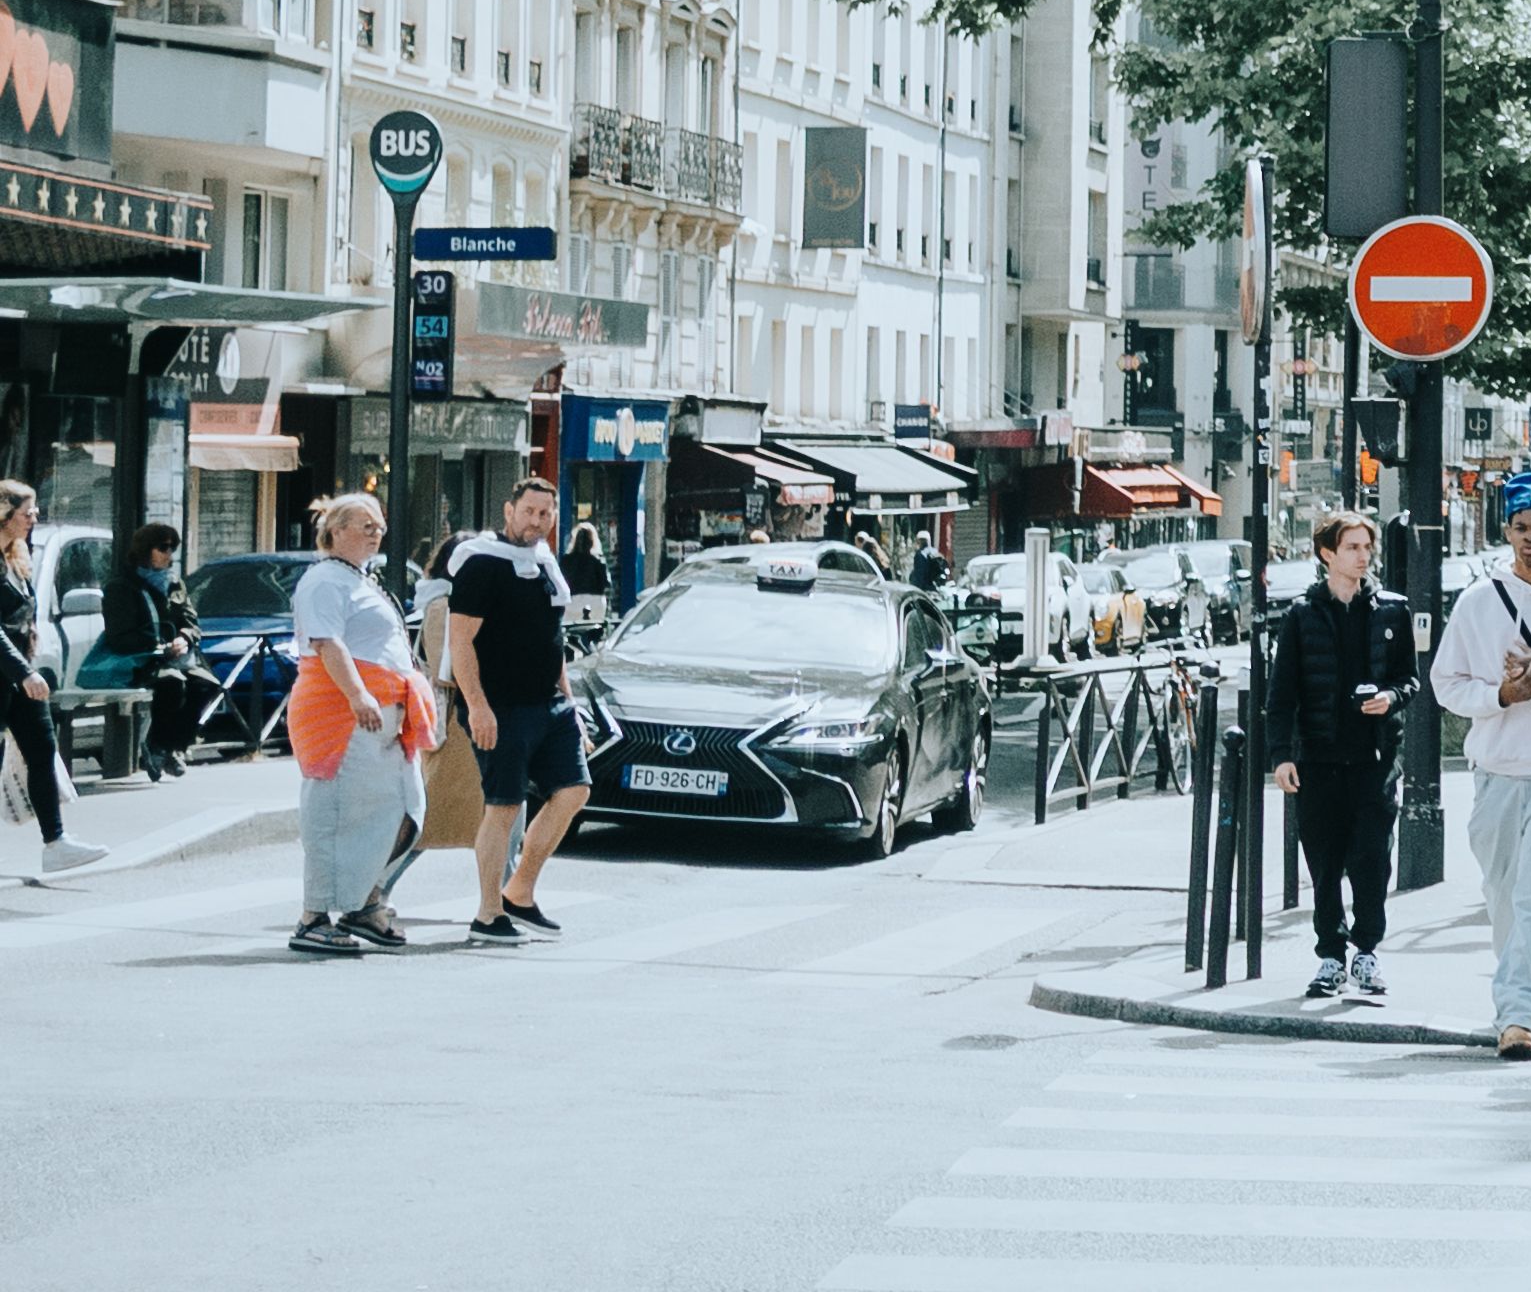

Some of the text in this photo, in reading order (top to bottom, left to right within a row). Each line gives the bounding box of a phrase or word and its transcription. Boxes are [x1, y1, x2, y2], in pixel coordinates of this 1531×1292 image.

[380, 129, 431, 157] BUS
[450, 236, 517, 252] Blanche
[421, 275, 445, 294] 30
[420, 319, 444, 335] 54
[769, 564, 803, 577] TAXI
[633, 769, 718, 791] FD-926-CH
